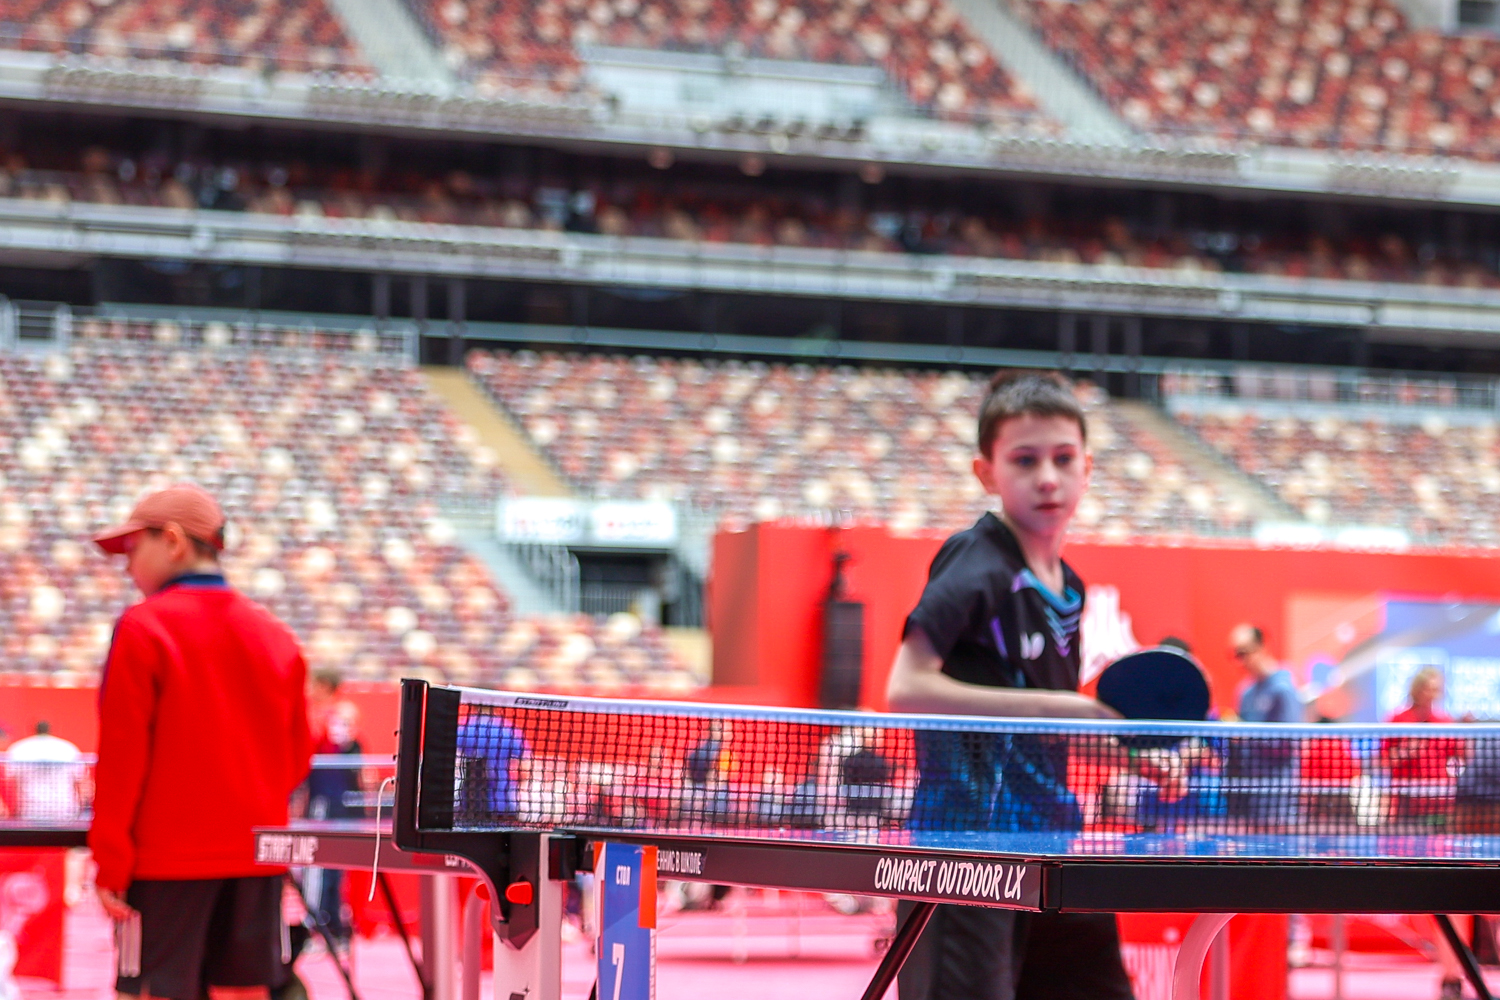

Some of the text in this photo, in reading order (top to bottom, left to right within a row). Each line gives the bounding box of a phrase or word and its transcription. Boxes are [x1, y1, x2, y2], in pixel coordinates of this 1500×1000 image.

[681, 851, 702, 875] ШКОЛЕ
[874, 857, 1027, 901] COMPACT OUTDOOR LX
